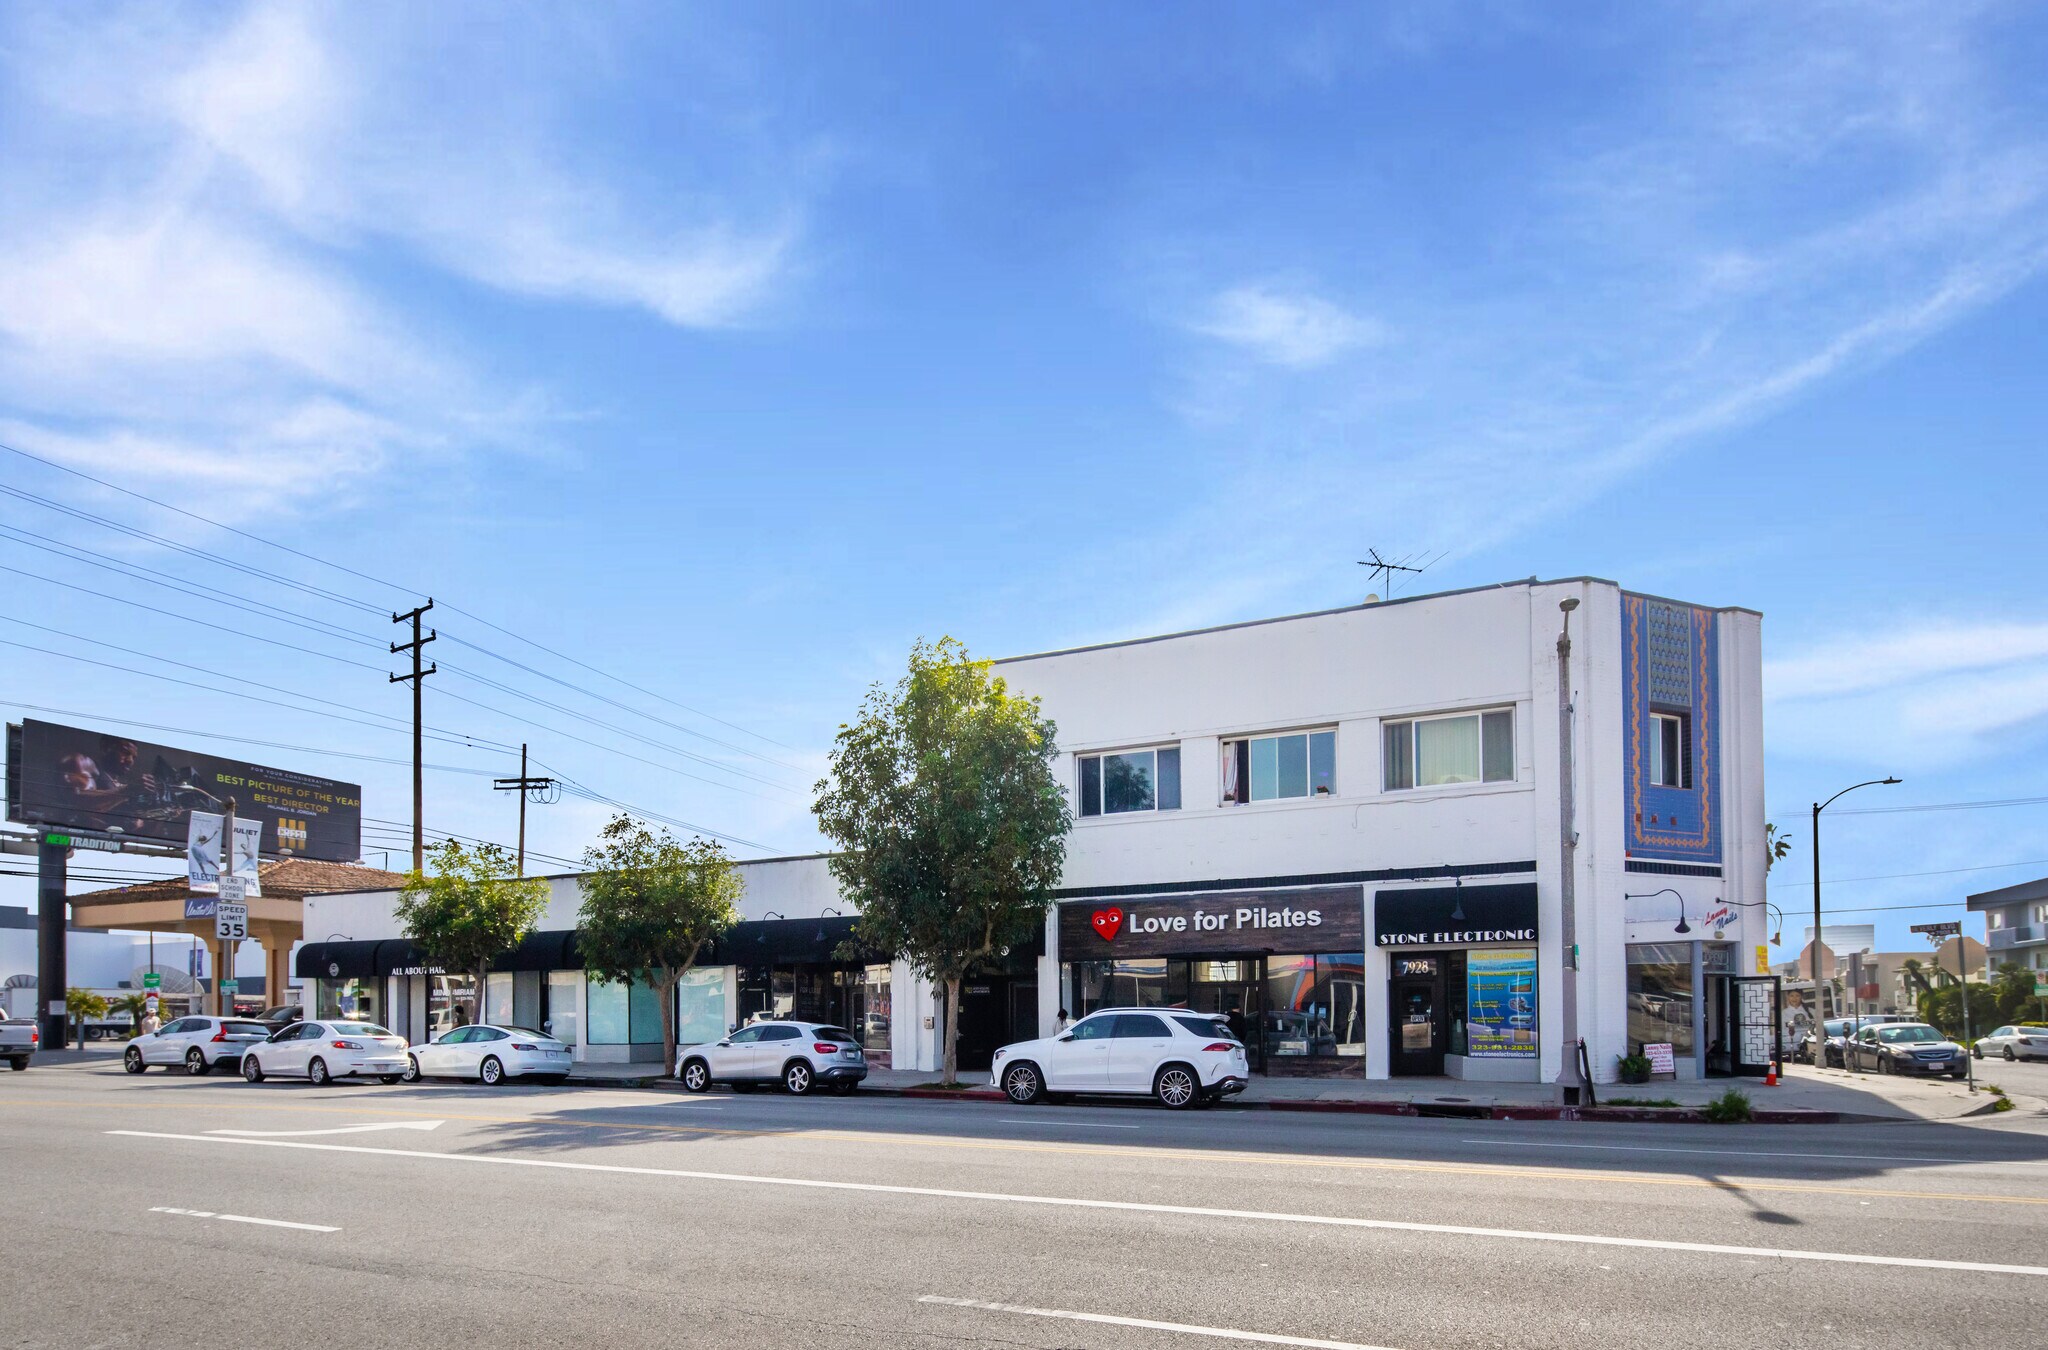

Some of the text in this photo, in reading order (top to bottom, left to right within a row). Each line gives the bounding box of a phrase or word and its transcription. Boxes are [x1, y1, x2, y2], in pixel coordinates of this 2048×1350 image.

[266, 769, 283, 777] YOUR
[284, 773, 334, 787] CONSIDERATION
[216, 774, 360, 808] BEST PICTURE OF THE YEAR
[254, 793, 329, 813] BEST DIRECTOR
[267, 804, 290, 812] MICHAEL
[46, 834, 121, 851] NEW TRADITION
[221, 884, 244, 892] SCHOOL
[219, 905, 246, 913] SPEED
[1704, 906, 1728, 926] Lanny
[1129, 907, 1322, 933] Love for Pilates
[1715, 911, 1738, 929] Nails
[219, 923, 244, 937] 35
[1380, 928, 1535, 945] STONE ELECTRONIC
[391, 968, 403, 976] ALL
[404, 967, 428, 975] ABOUT
[1402, 961, 1429, 974] 7928
